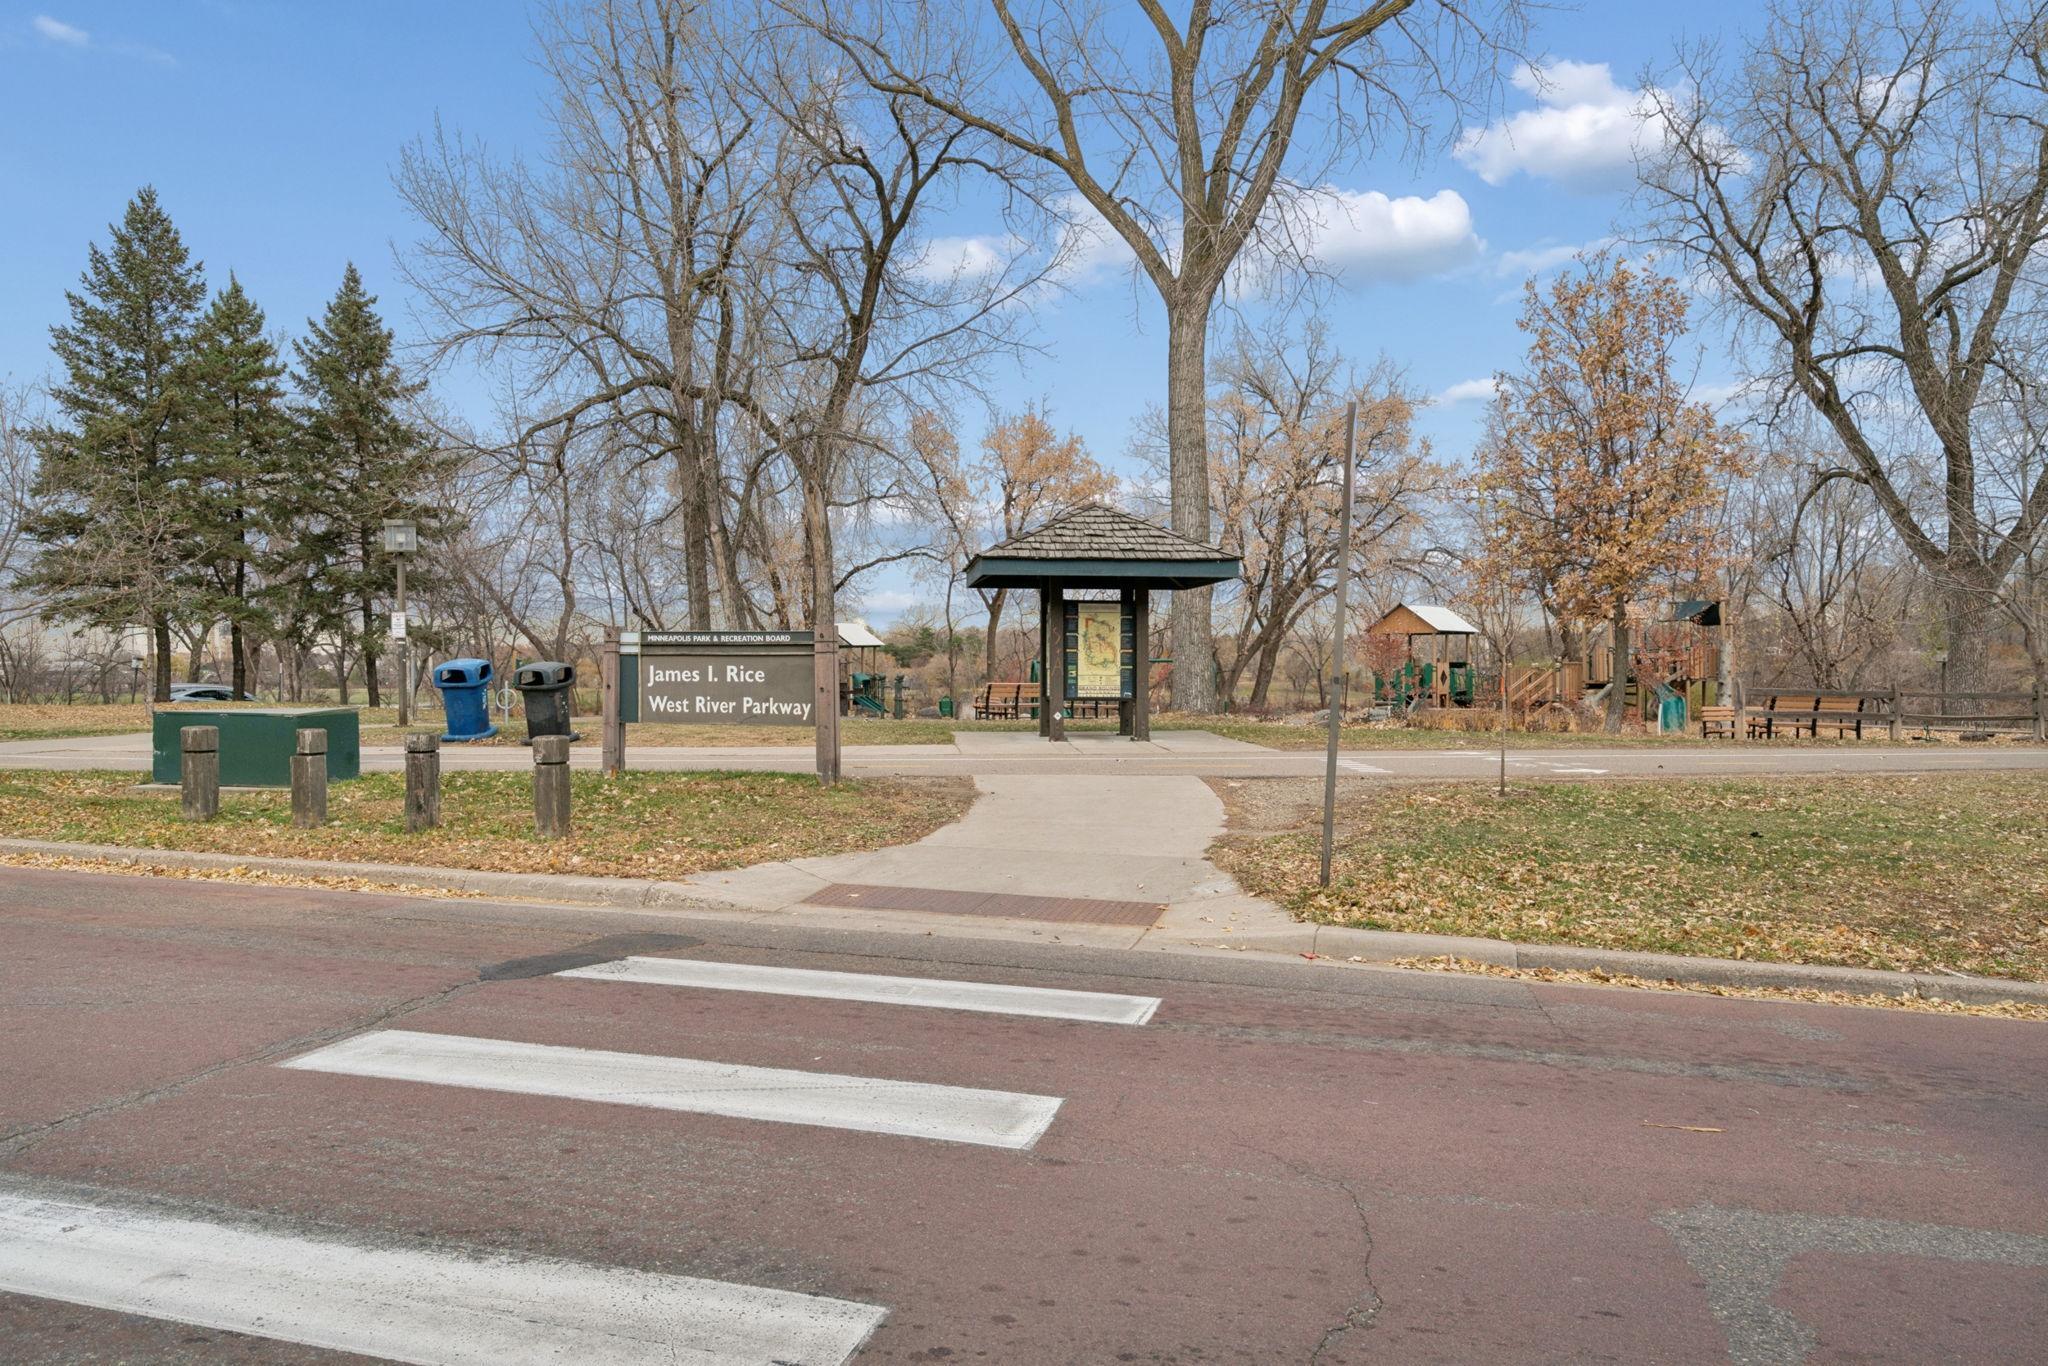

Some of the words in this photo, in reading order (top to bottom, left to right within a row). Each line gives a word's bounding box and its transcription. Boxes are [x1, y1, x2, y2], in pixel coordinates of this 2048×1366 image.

[647, 664, 700, 687] James
[708, 665, 718, 682] I.
[726, 665, 766, 682] Rice
[648, 695, 690, 712] West
[695, 696, 736, 713] River
[743, 697, 811, 720] Parkway
